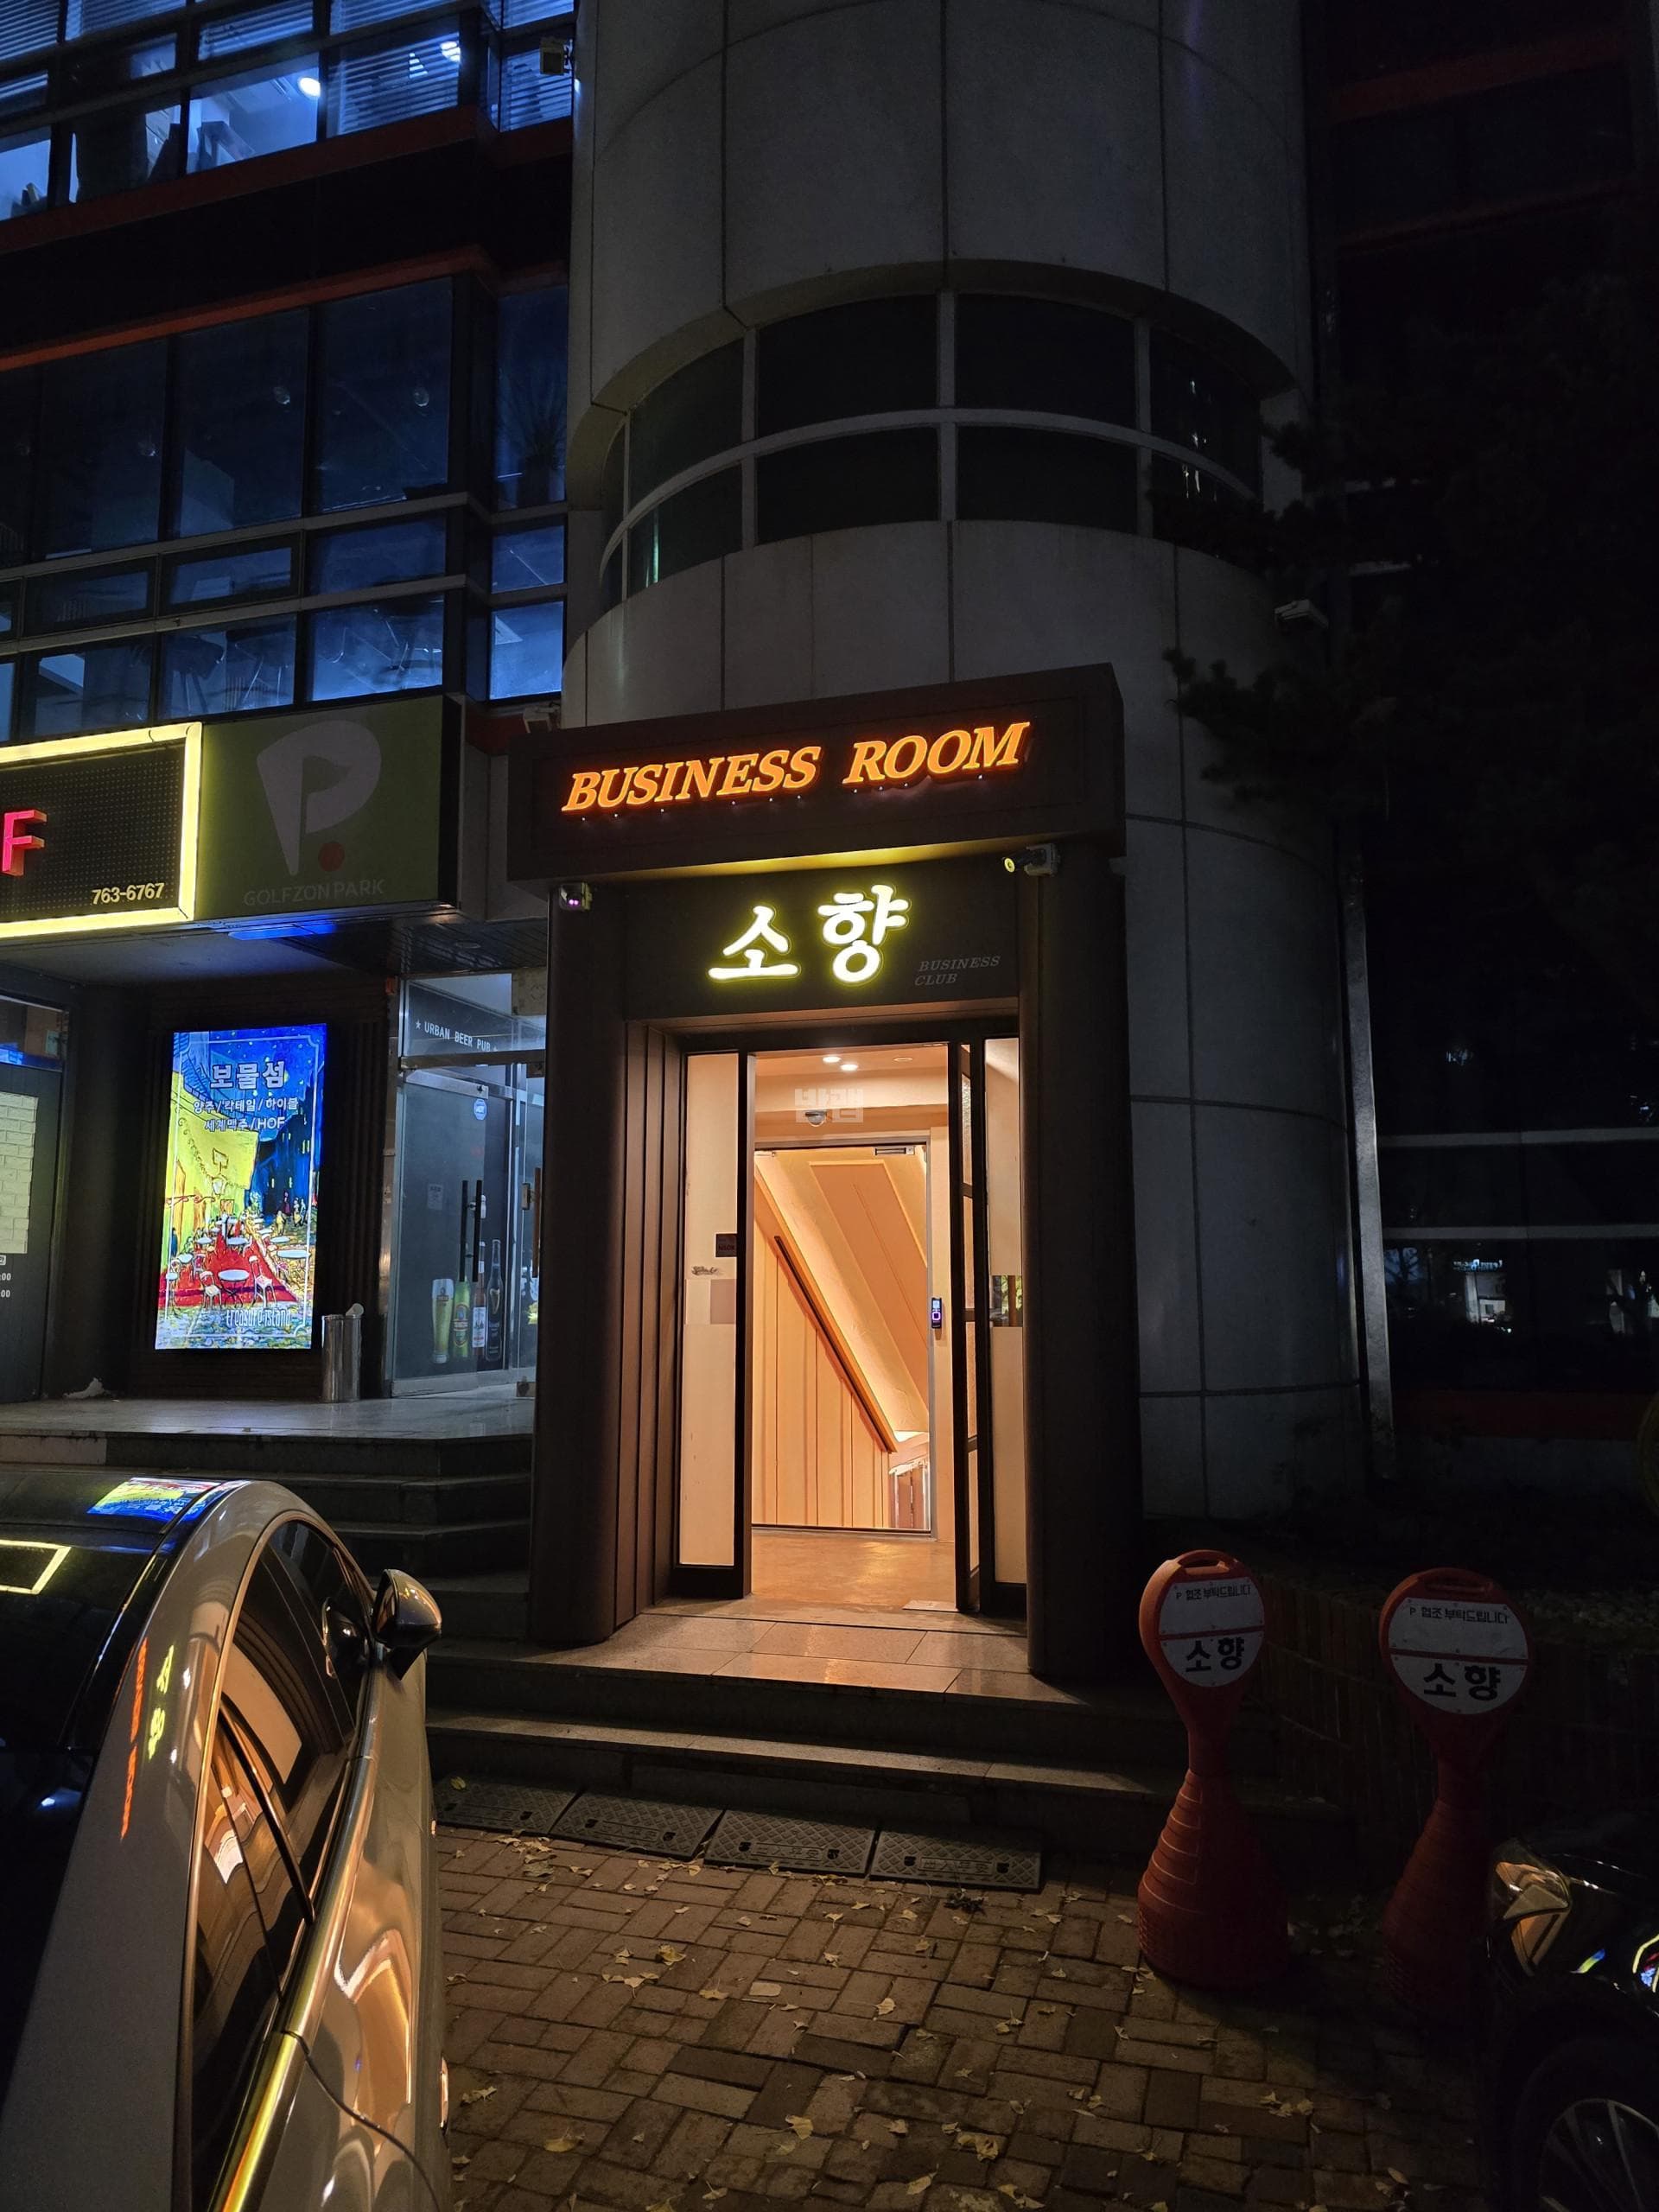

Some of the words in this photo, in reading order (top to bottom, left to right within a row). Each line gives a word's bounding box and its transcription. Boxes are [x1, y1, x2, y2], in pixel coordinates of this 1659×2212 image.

[562, 746, 822, 812] BUSINESS
[842, 721, 1030, 785] ROOM
[92, 882, 165, 905] 763-6767
[244, 884, 330, 906] GOLFZON
[334, 879, 385, 900] PARK
[708, 884, 909, 982] 소향
[918, 955, 1001, 972] BUSINESS
[914, 973, 958, 986] CLUB
[424, 1021, 450, 1040] URBAN
[454, 1031, 474, 1048] BEER
[476, 1039, 491, 1052] PUB
[210, 1060, 285, 1090] 보물섬
[1421, 1606, 1442, 1619] 협조
[1445, 1608, 1509, 1624] 부탁드립니다
[1185, 1637, 1245, 1672] 소향
[1423, 1663, 1501, 1701] 소향
